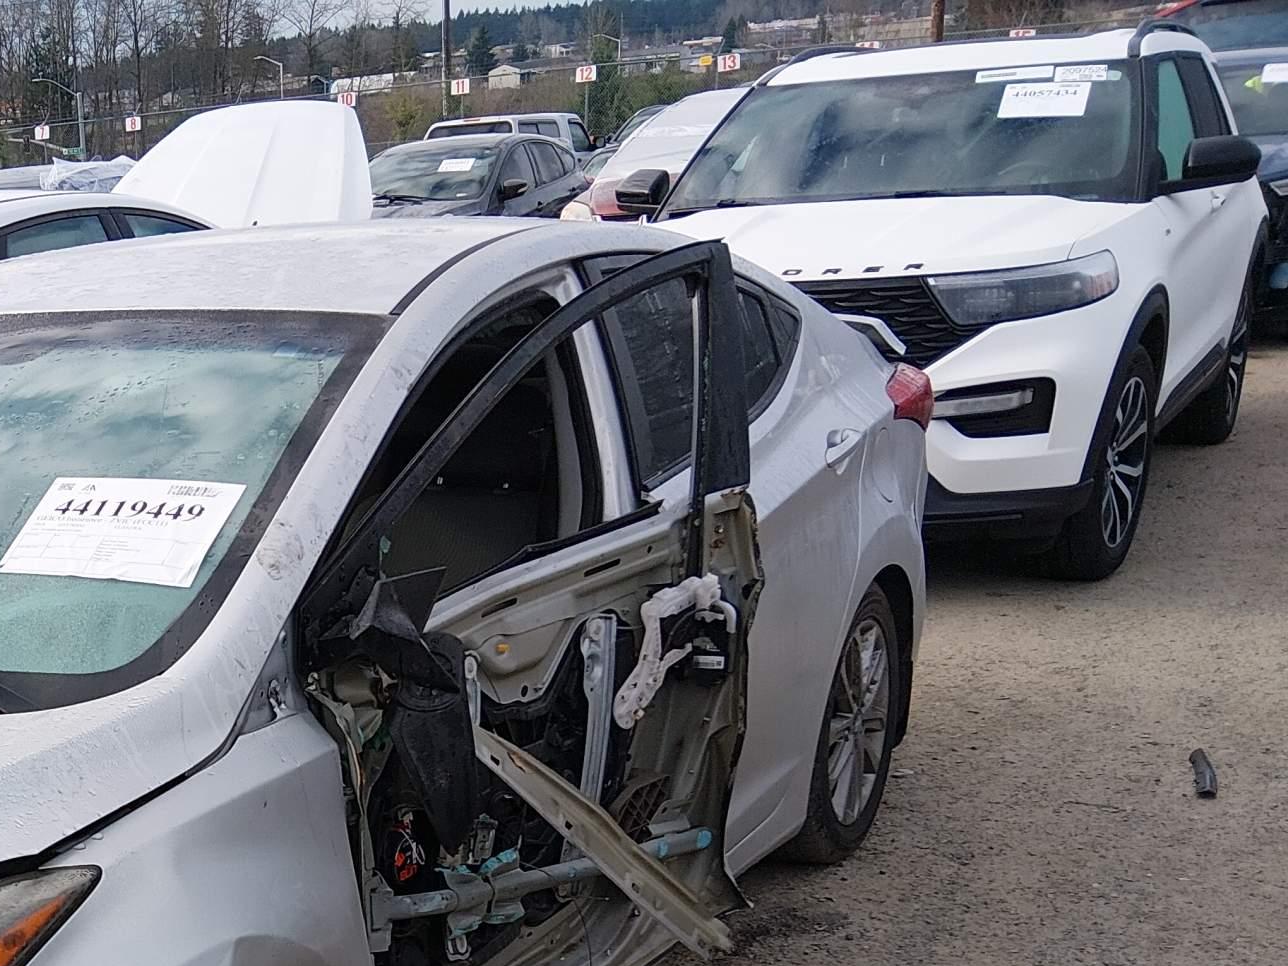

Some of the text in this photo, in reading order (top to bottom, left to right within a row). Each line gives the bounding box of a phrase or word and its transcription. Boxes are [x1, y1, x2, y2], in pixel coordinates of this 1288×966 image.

[721, 55, 737, 69] 13
[579, 68, 592, 81] 12
[455, 80, 465, 93] 11
[341, 93, 353, 105] 10
[130, 119, 136, 130] 8
[54, 498, 205, 523] 44119449
